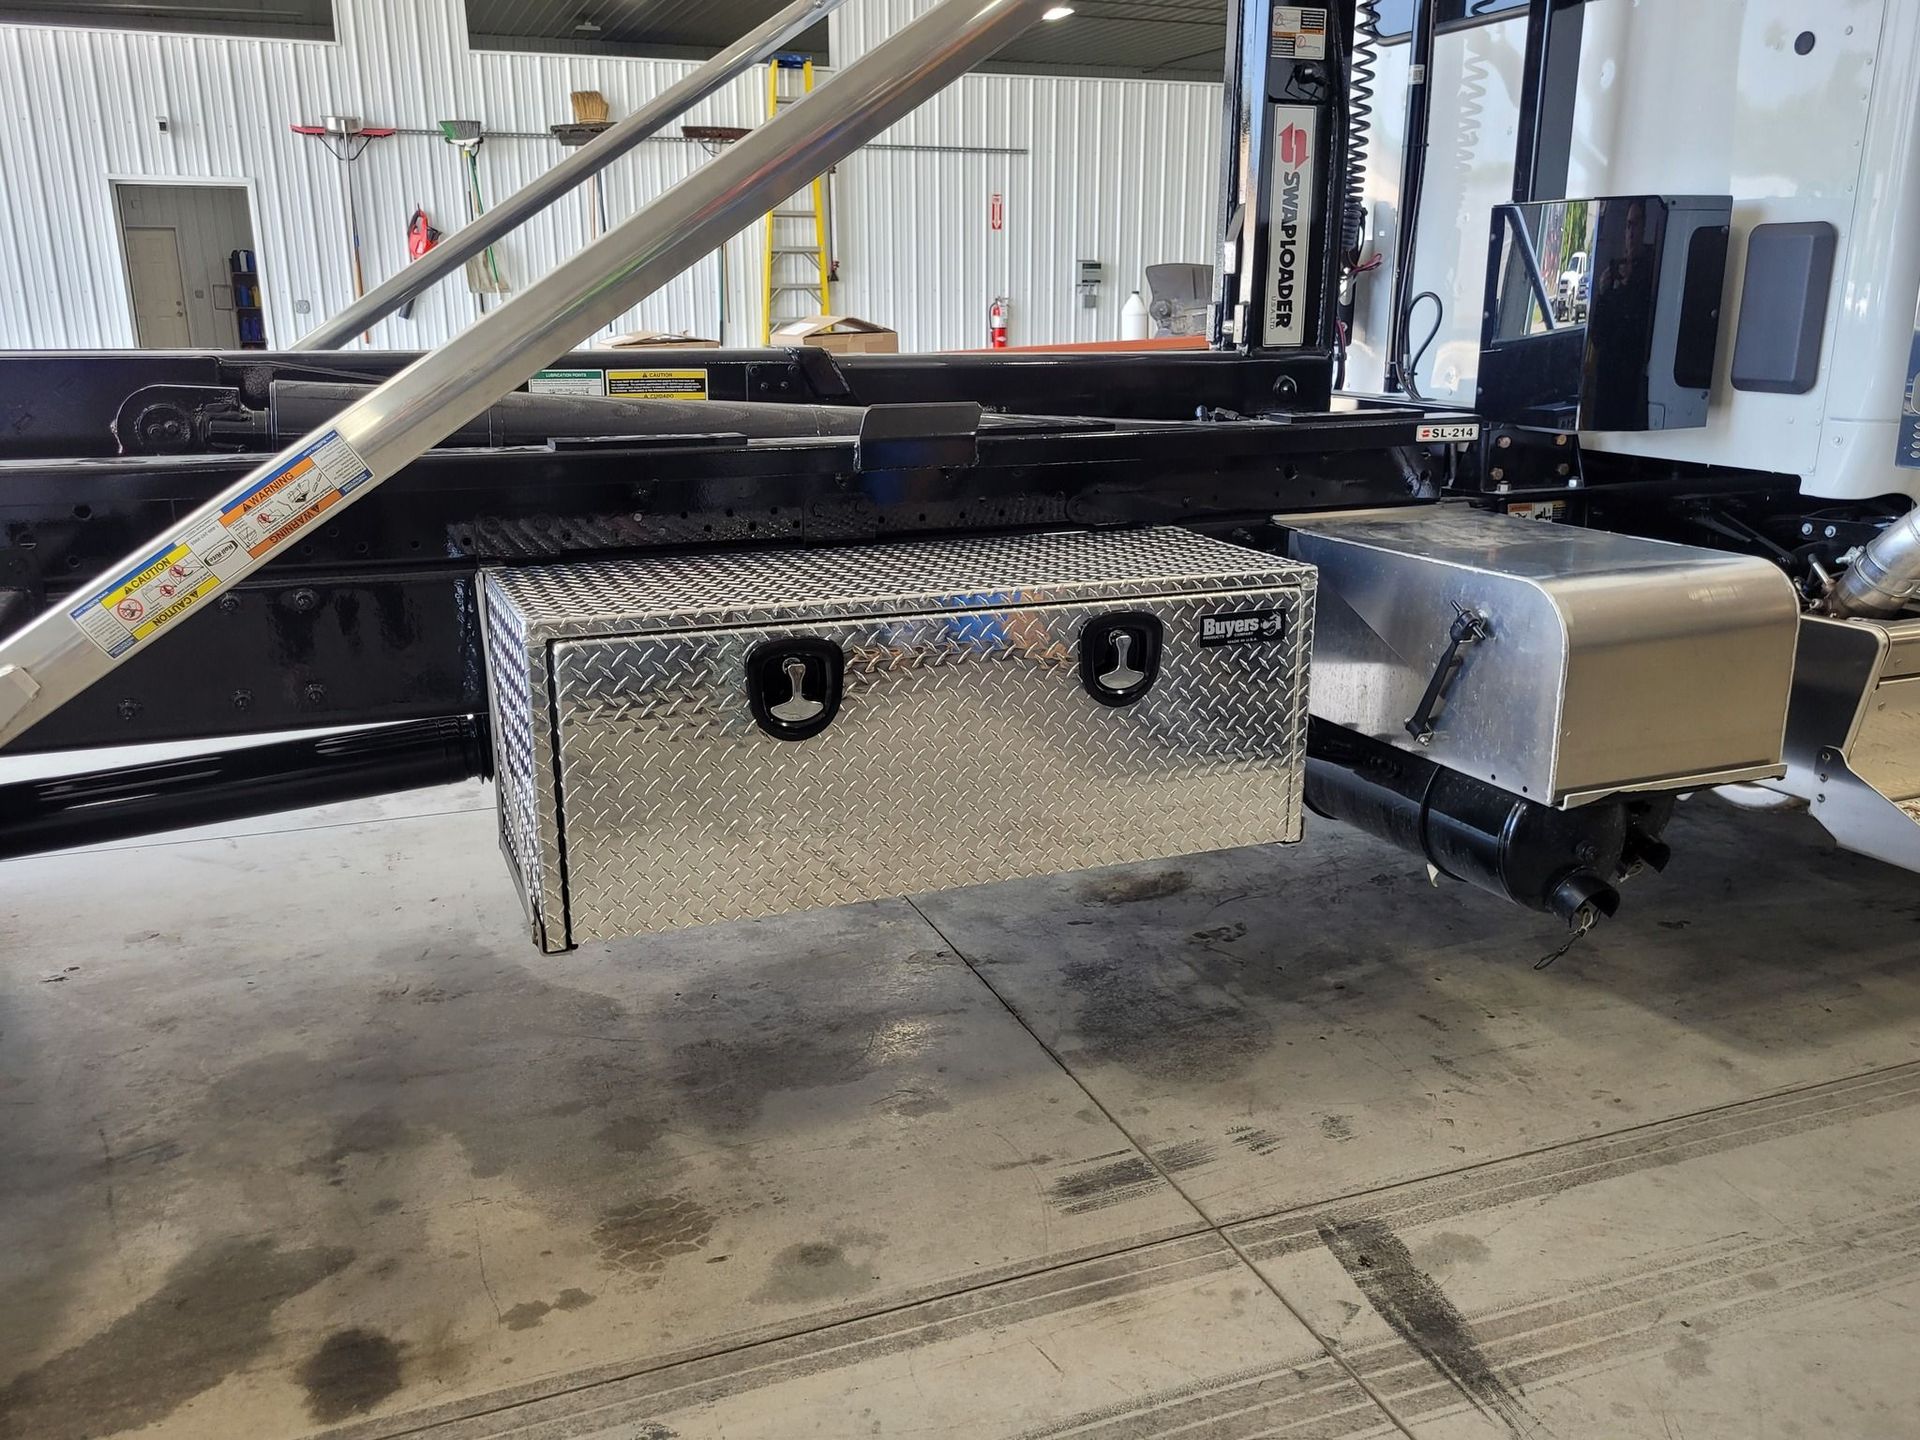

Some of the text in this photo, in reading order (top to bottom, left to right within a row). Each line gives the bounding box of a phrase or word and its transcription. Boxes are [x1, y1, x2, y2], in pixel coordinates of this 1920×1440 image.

[1275, 171, 1301, 328] SWAPLOADER
[1432, 428, 1473, 438] SL-214
[248, 471, 294, 506] WARNING
[269, 509, 314, 544] WARNING
[130, 557, 172, 589] CAUTION
[151, 595, 192, 627] CAUTION
[1203, 617, 1259, 638] Buyers
